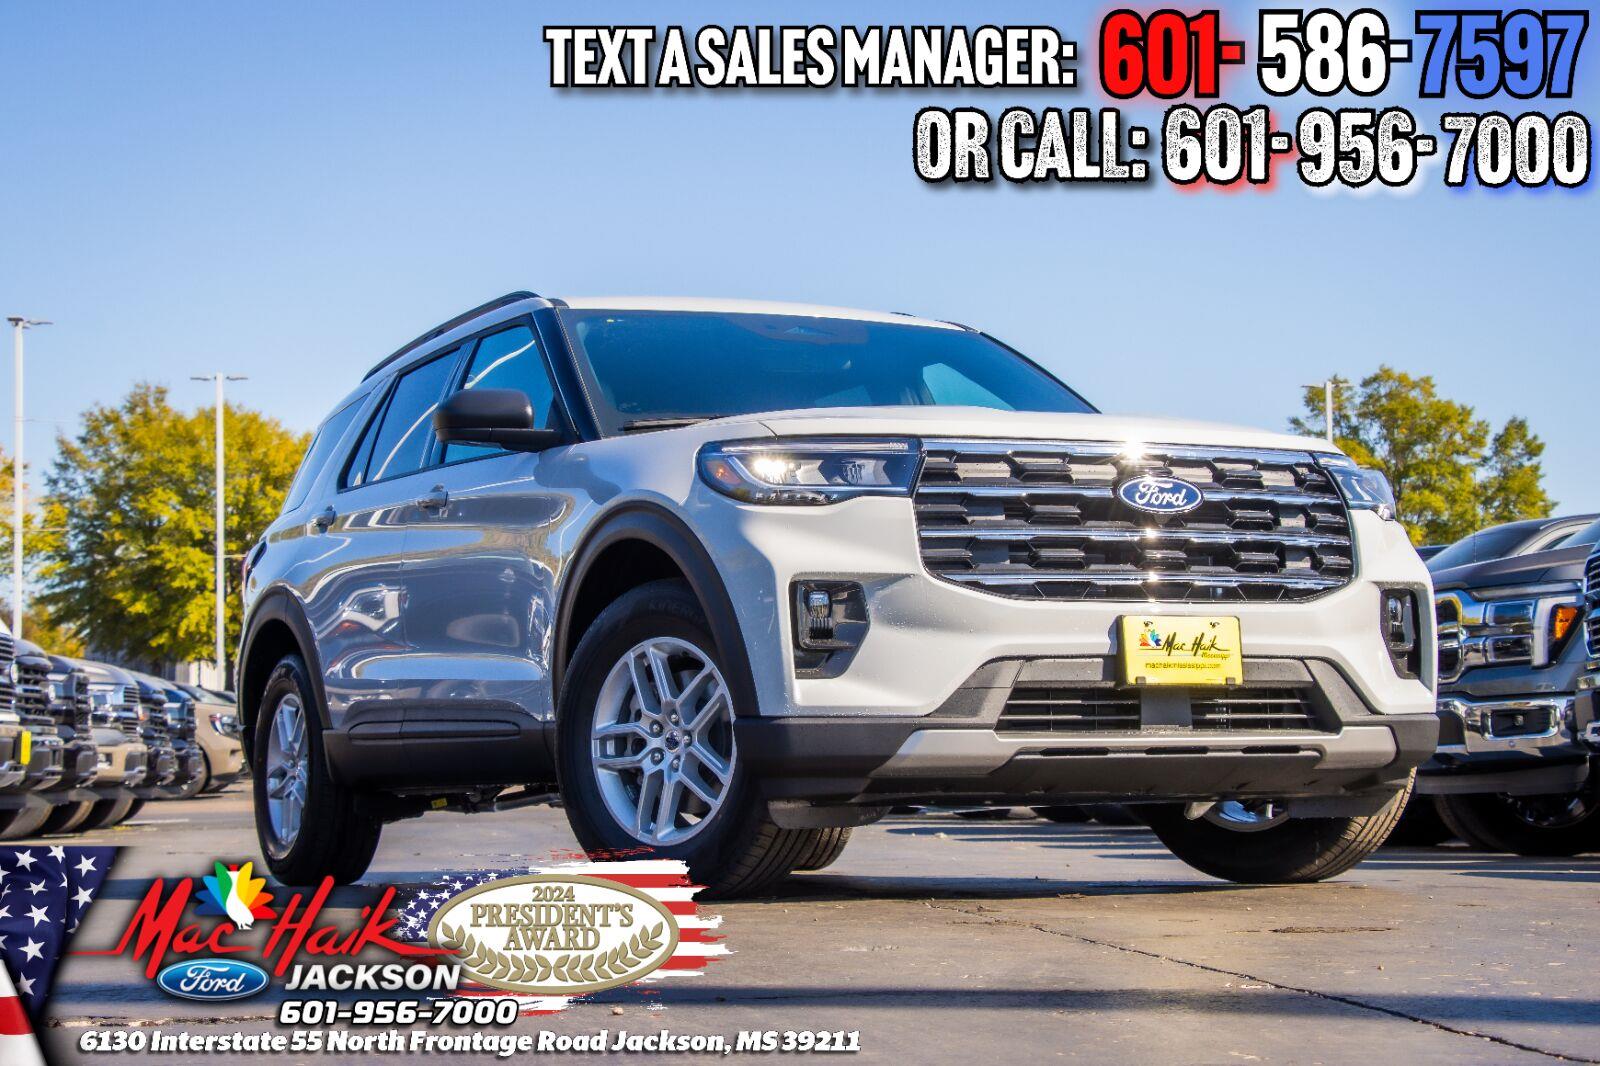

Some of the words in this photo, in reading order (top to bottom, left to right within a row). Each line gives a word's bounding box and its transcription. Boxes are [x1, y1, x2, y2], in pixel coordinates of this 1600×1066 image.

[1135, 482, 1187, 506] Ford
[1161, 632, 1186, 656] Mac
[1190, 632, 1222, 656] Haik
